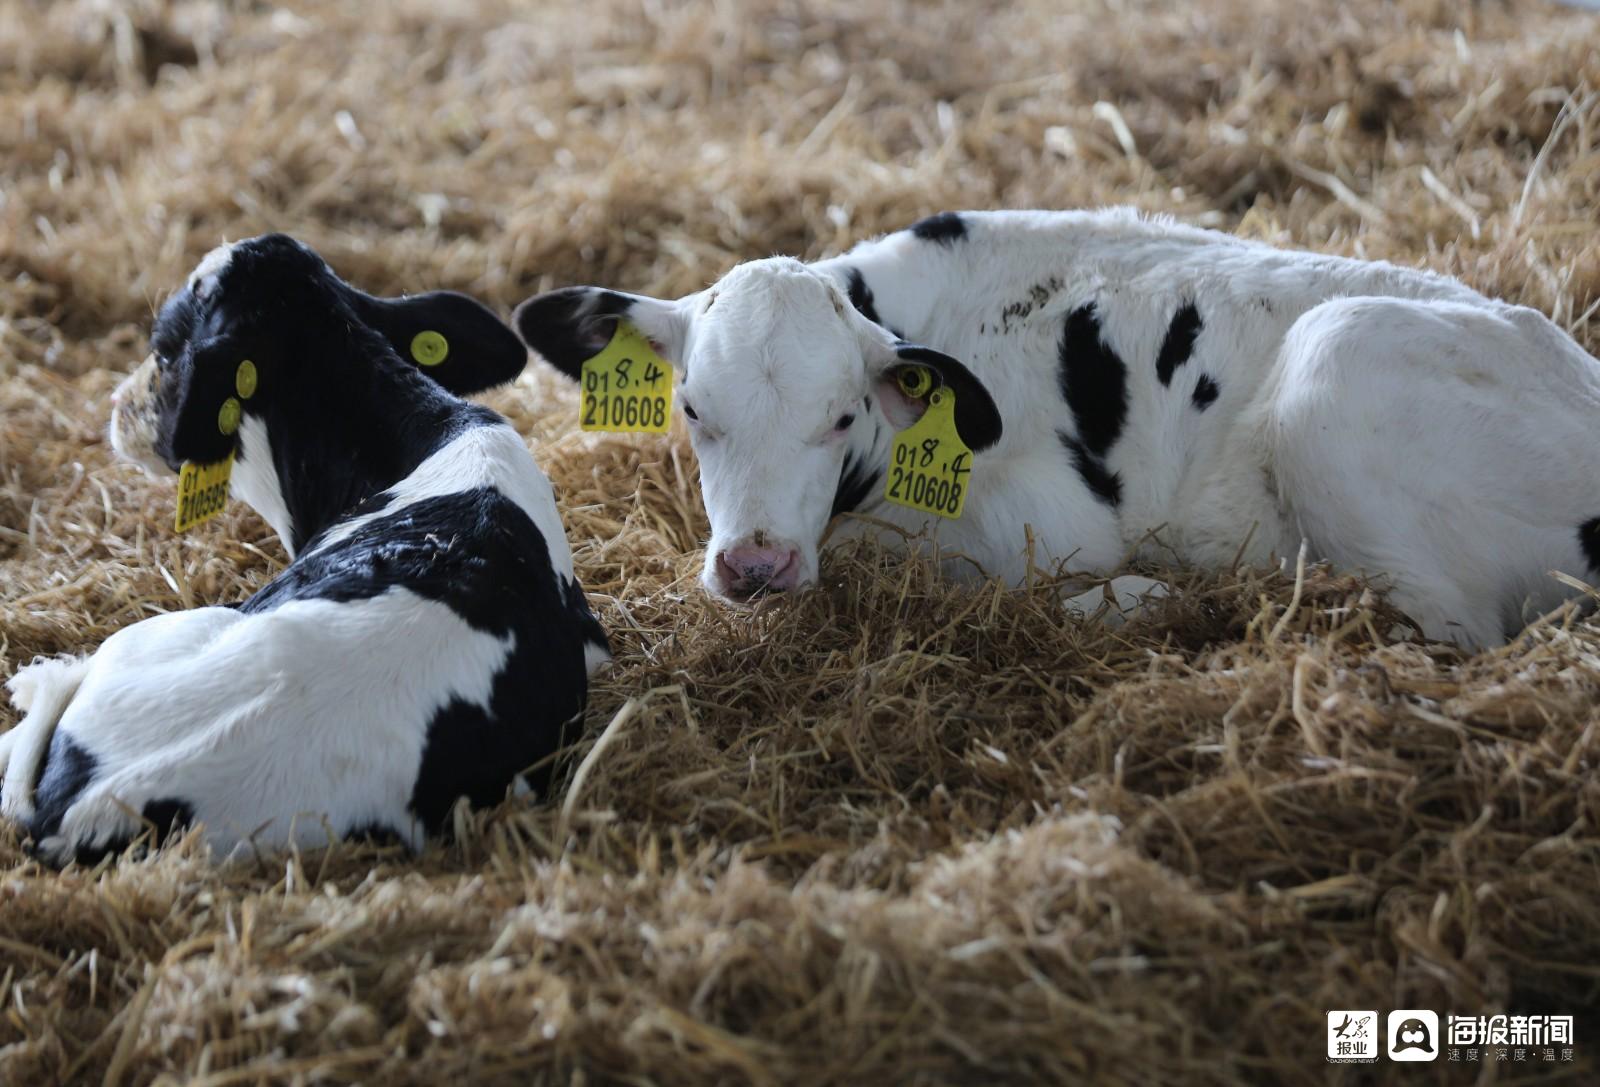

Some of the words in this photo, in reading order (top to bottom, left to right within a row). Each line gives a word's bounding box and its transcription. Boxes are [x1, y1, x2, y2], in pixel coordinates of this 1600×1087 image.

[586, 371, 608, 392] 01
[615, 358, 664, 390] 8.4
[583, 394, 666, 427] 210608
[889, 467, 962, 514] 210608
